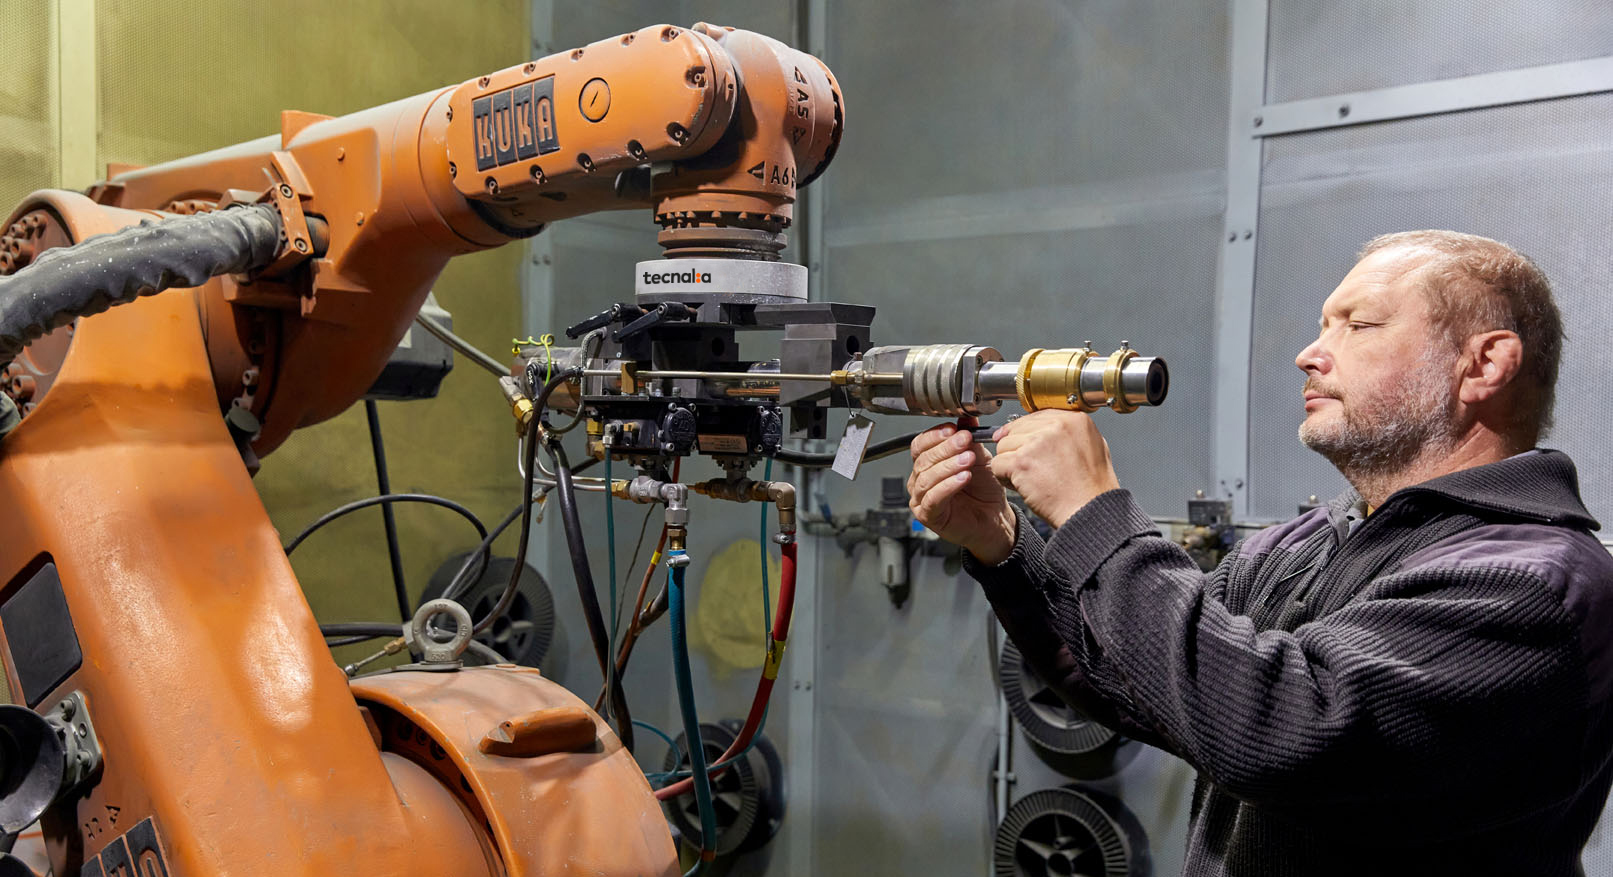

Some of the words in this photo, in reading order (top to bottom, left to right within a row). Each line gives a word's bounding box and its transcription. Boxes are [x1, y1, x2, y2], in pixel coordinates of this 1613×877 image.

[797, 88, 809, 119] A5
[476, 96, 553, 159] KUKA
[770, 165, 789, 185] A6
